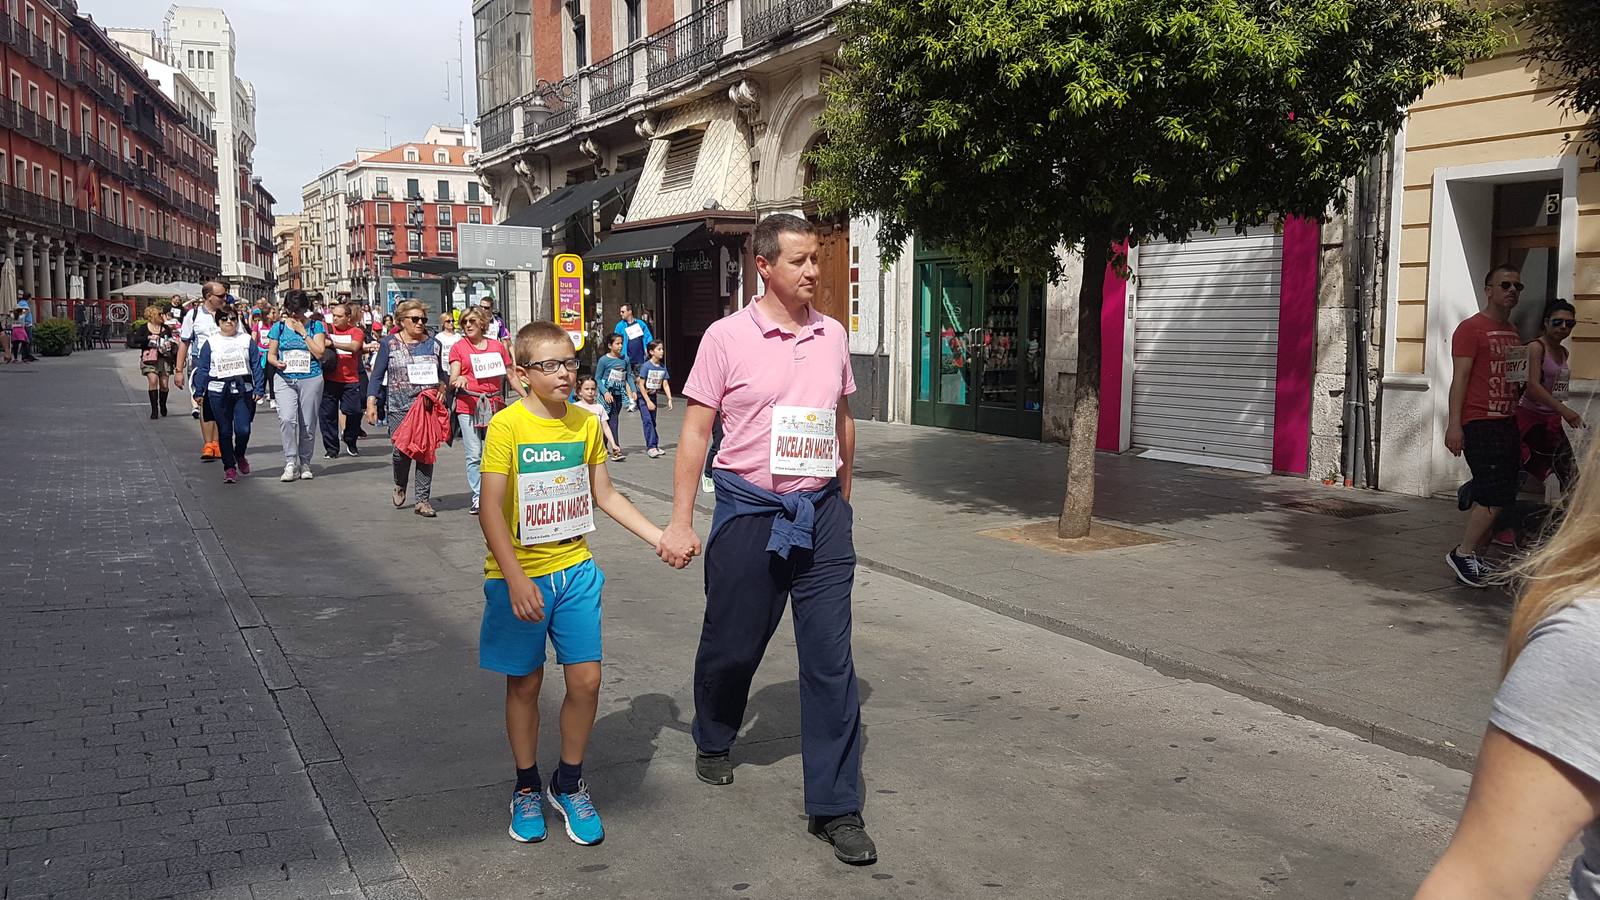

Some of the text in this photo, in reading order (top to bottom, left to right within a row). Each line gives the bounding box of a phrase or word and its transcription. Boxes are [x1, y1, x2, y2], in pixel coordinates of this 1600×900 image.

[1548, 196, 1558, 213] 3
[566, 262, 572, 272] 8
[776, 436, 834, 460] PUCELA EN MARCHE
[526, 494, 589, 526] PUCELA EN MARCHE
